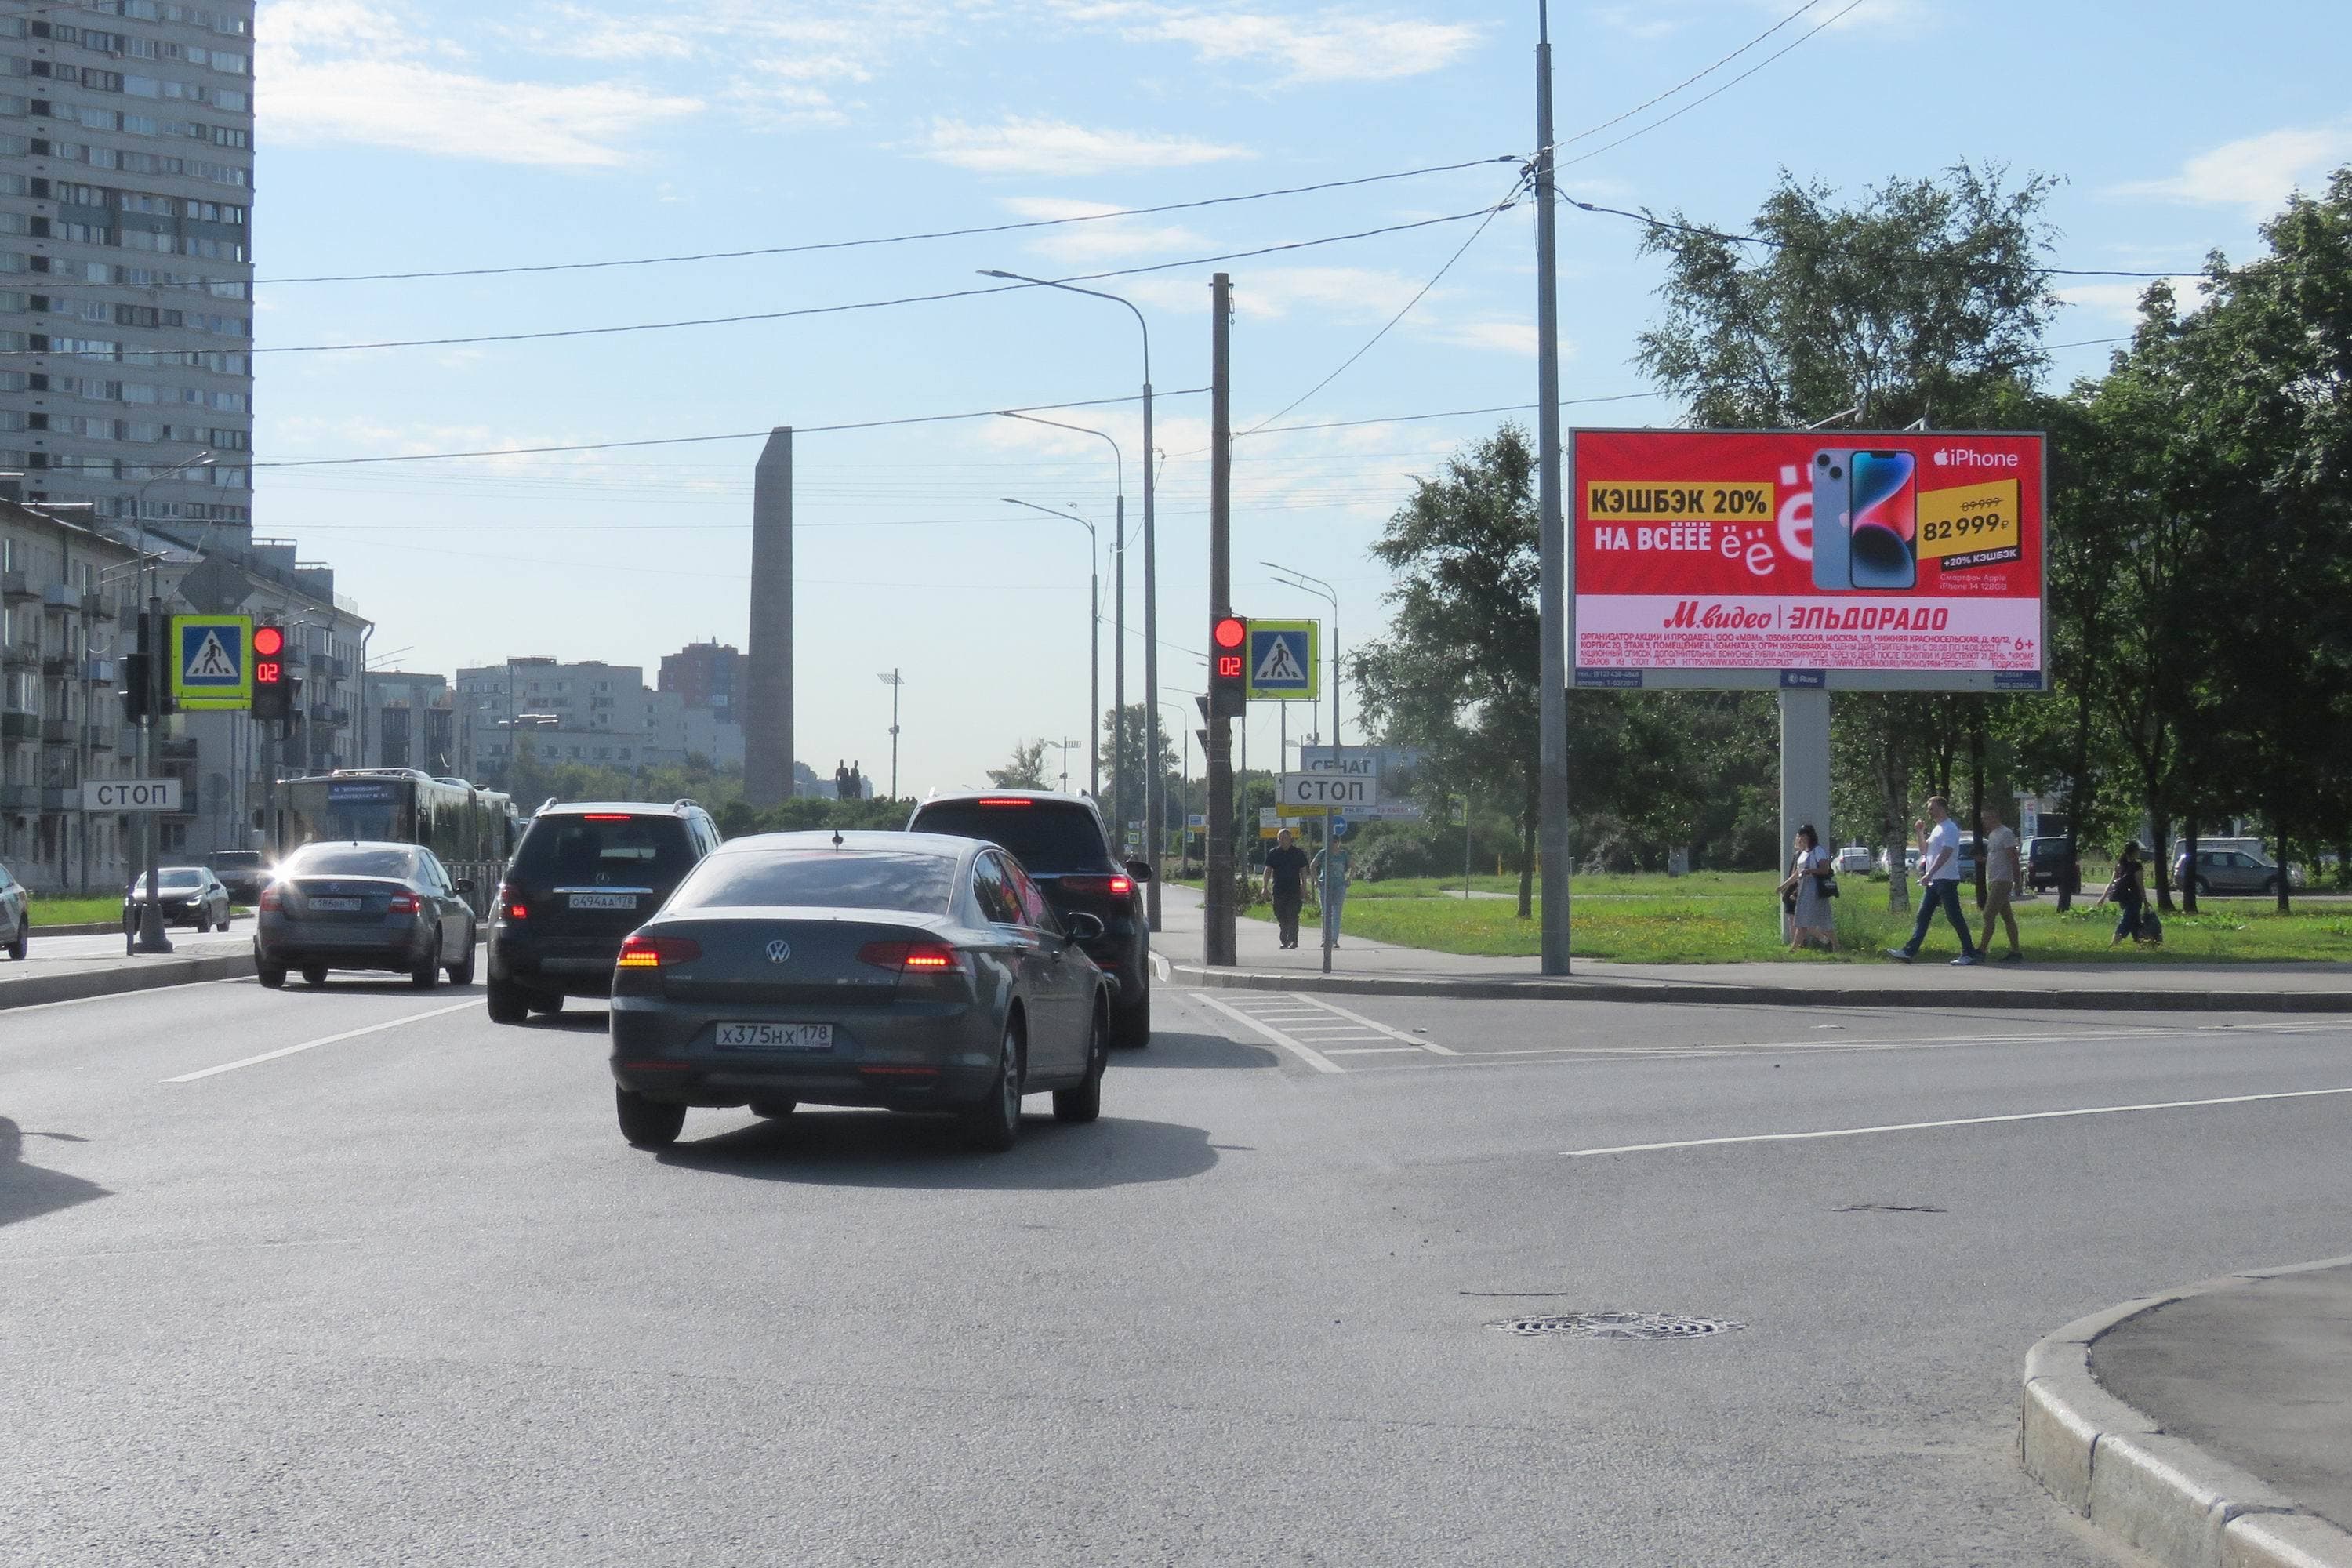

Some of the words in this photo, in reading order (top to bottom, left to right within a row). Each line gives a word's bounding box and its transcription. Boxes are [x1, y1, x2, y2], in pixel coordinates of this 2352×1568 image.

[1951, 448, 2018, 466] iPhone
[1592, 488, 1704, 514] КЭШБЭК
[1713, 488, 1767, 514] 20%
[1595, 527, 1630, 550] НА
[1637, 522, 1711, 550] ВСЁЁЁ
[1944, 555, 1971, 567] +20%
[1973, 549, 2017, 563] КЭШБЭК
[1984, 574, 2007, 583] Apple
[1787, 607, 1949, 630] ЭЛЬДОРАДО
[1653, 642, 1704, 651] ПОМЕЩЕНИЕ
[1858, 643, 1920, 652] ДЕЙСТВИТЕЛЬНЫ
[2015, 637, 2034, 650] 6+
[1581, 649, 1623, 659] АКЦИОННЫЙ
[258, 663, 277, 681] 02
[1220, 657, 1240, 675] 02
[97, 786, 167, 804] СТОП
[1298, 780, 1363, 800] СТОП
[800, 1025, 828, 1040] 178
